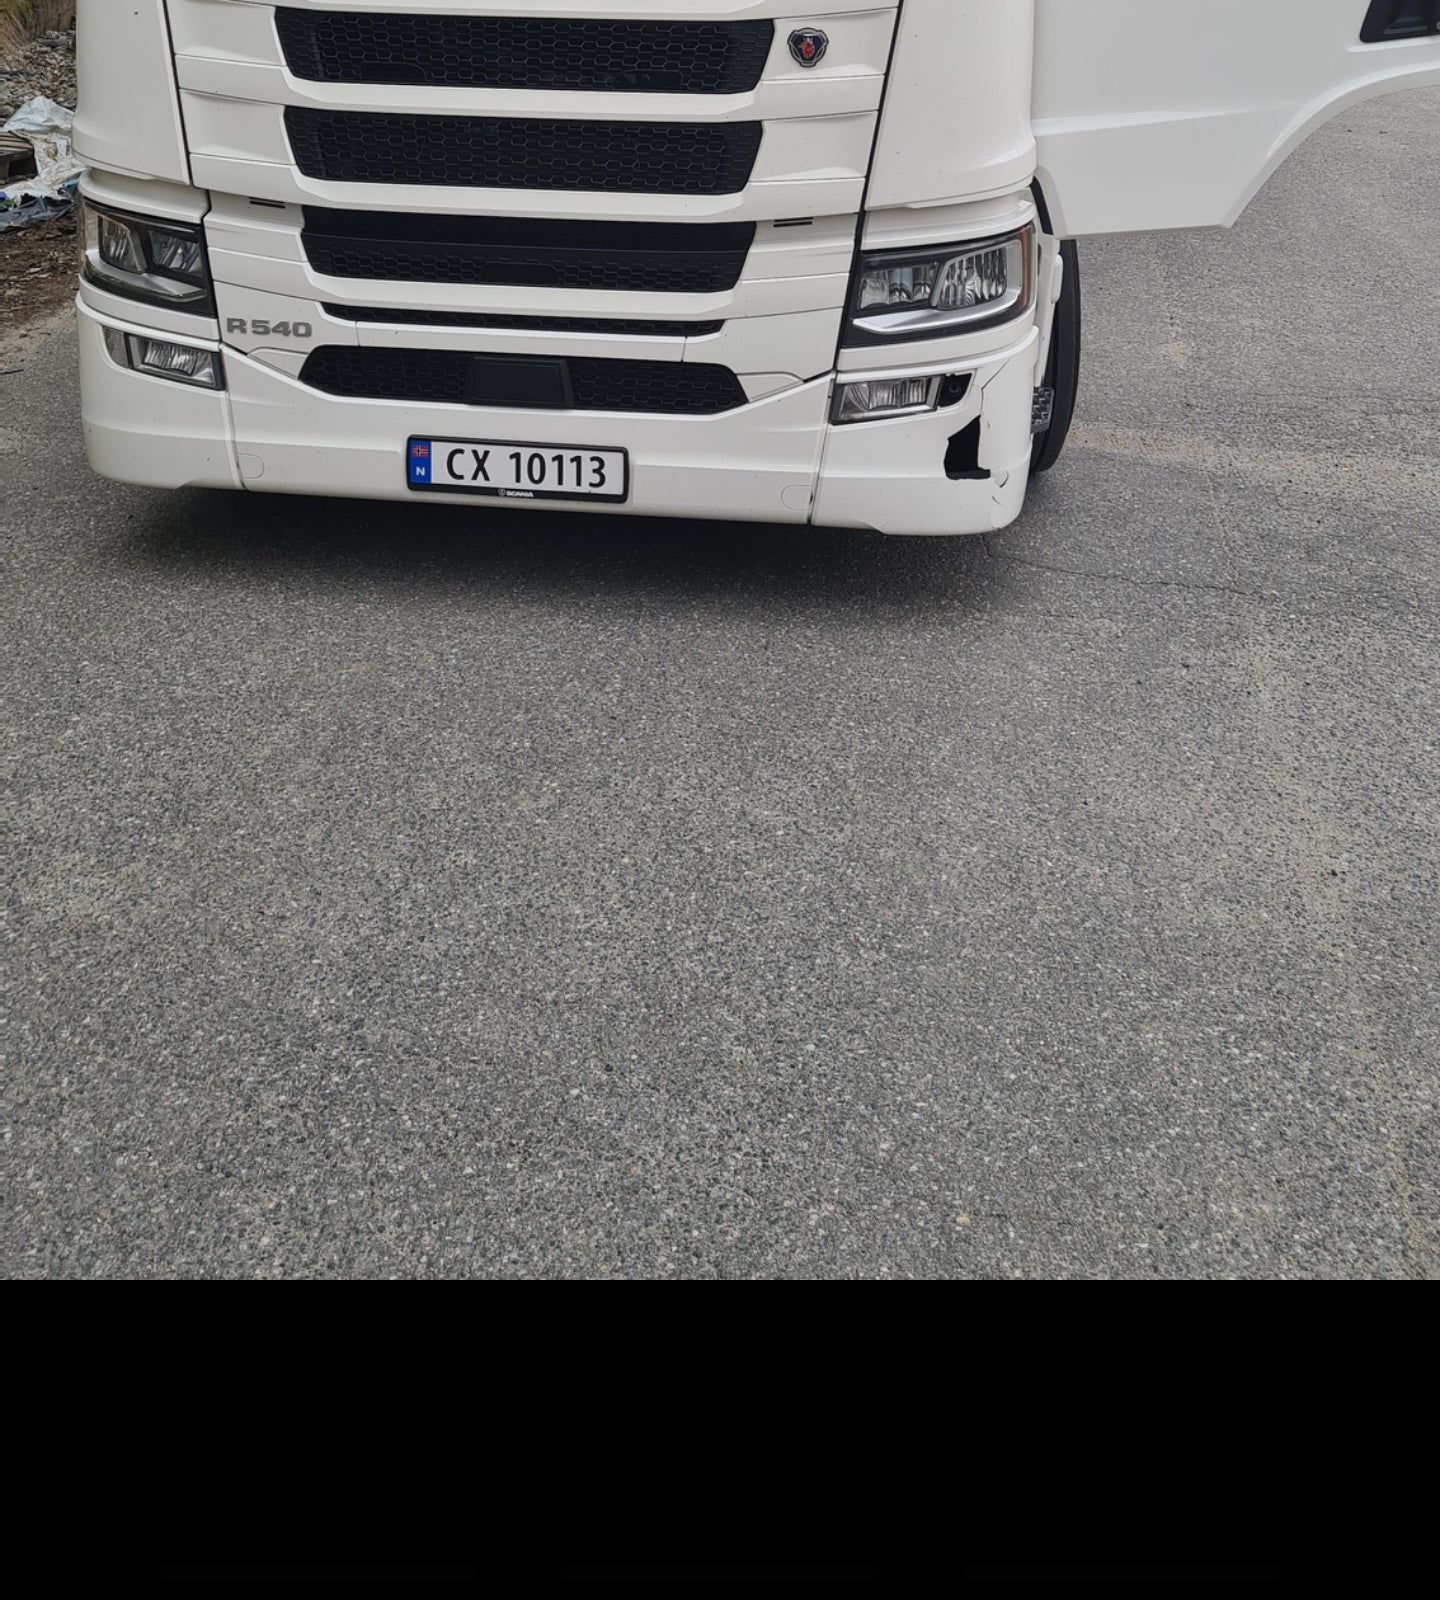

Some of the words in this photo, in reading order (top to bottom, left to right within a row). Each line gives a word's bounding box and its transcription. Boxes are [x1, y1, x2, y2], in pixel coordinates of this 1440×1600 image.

[226, 318, 247, 334] R
[251, 319, 312, 337] 540
[416, 466, 426, 477] N
[446, 448, 491, 481] CX
[509, 451, 607, 488] 10113
